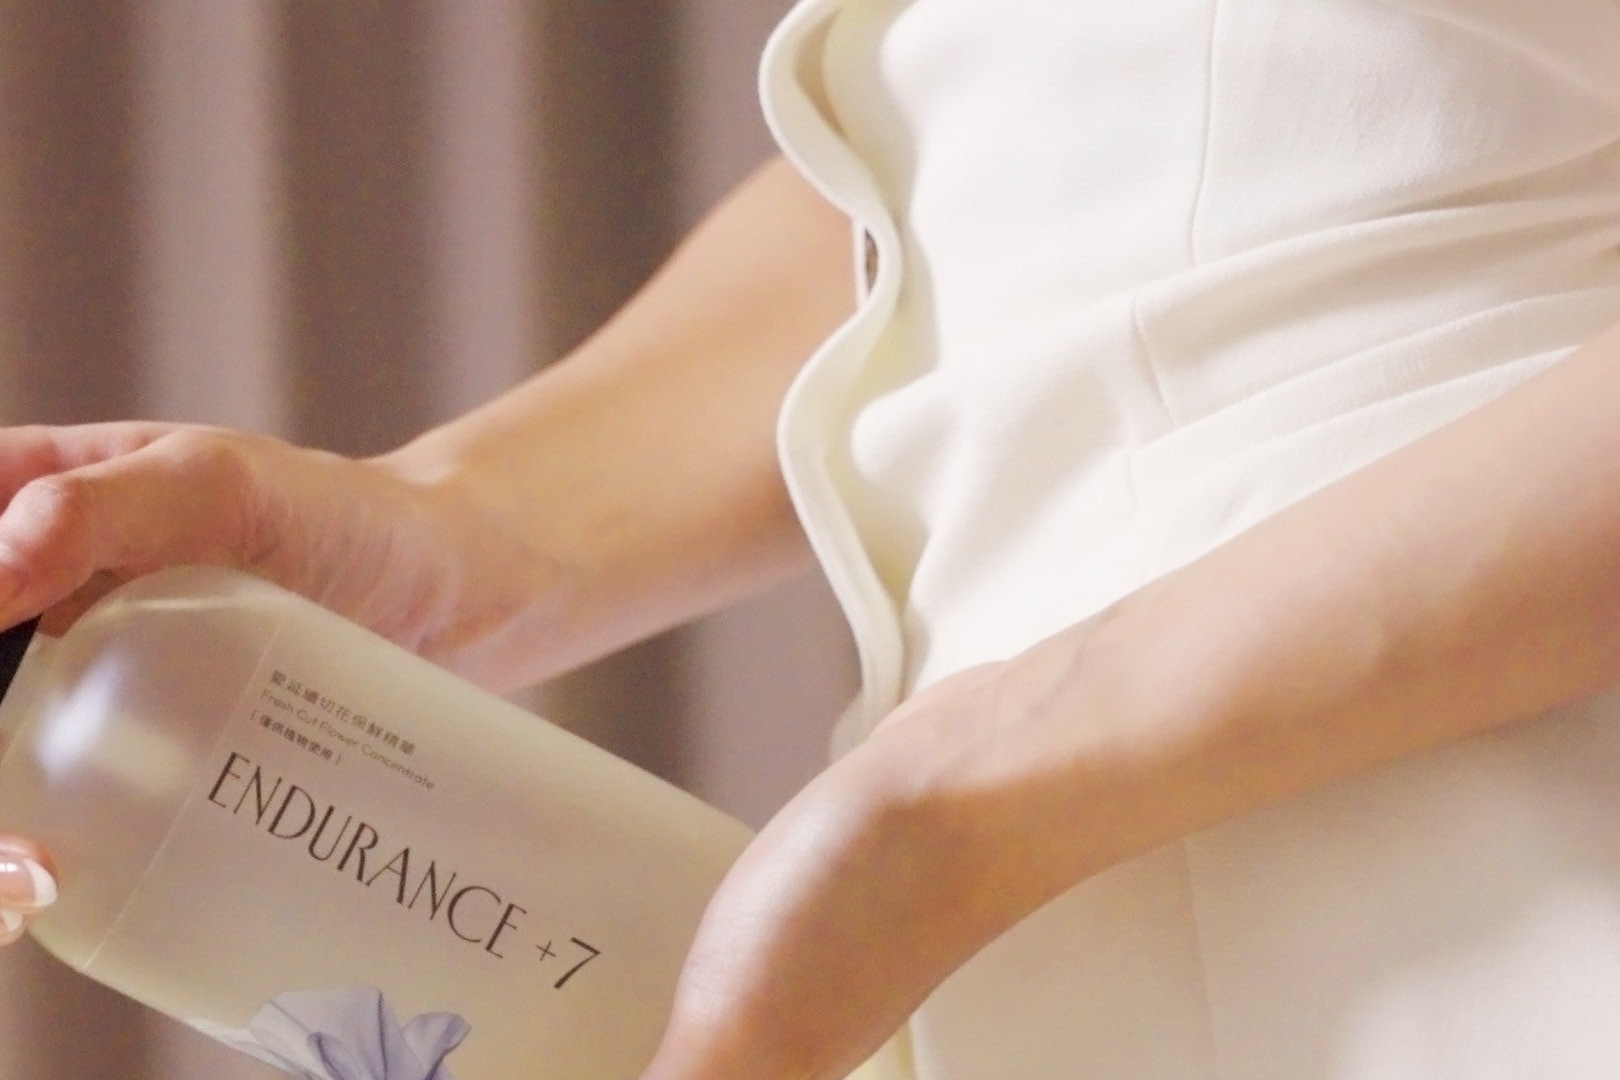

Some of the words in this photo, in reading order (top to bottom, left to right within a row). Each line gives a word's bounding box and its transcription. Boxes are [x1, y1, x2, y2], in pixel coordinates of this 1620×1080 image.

[261, 689, 294, 714] Fresh
[296, 708, 318, 725] Cut
[319, 721, 359, 746] Flower
[361, 743, 434, 790] Concentrate
[207, 751, 528, 960] ENDURANCE
[535, 936, 601, 990] +7
